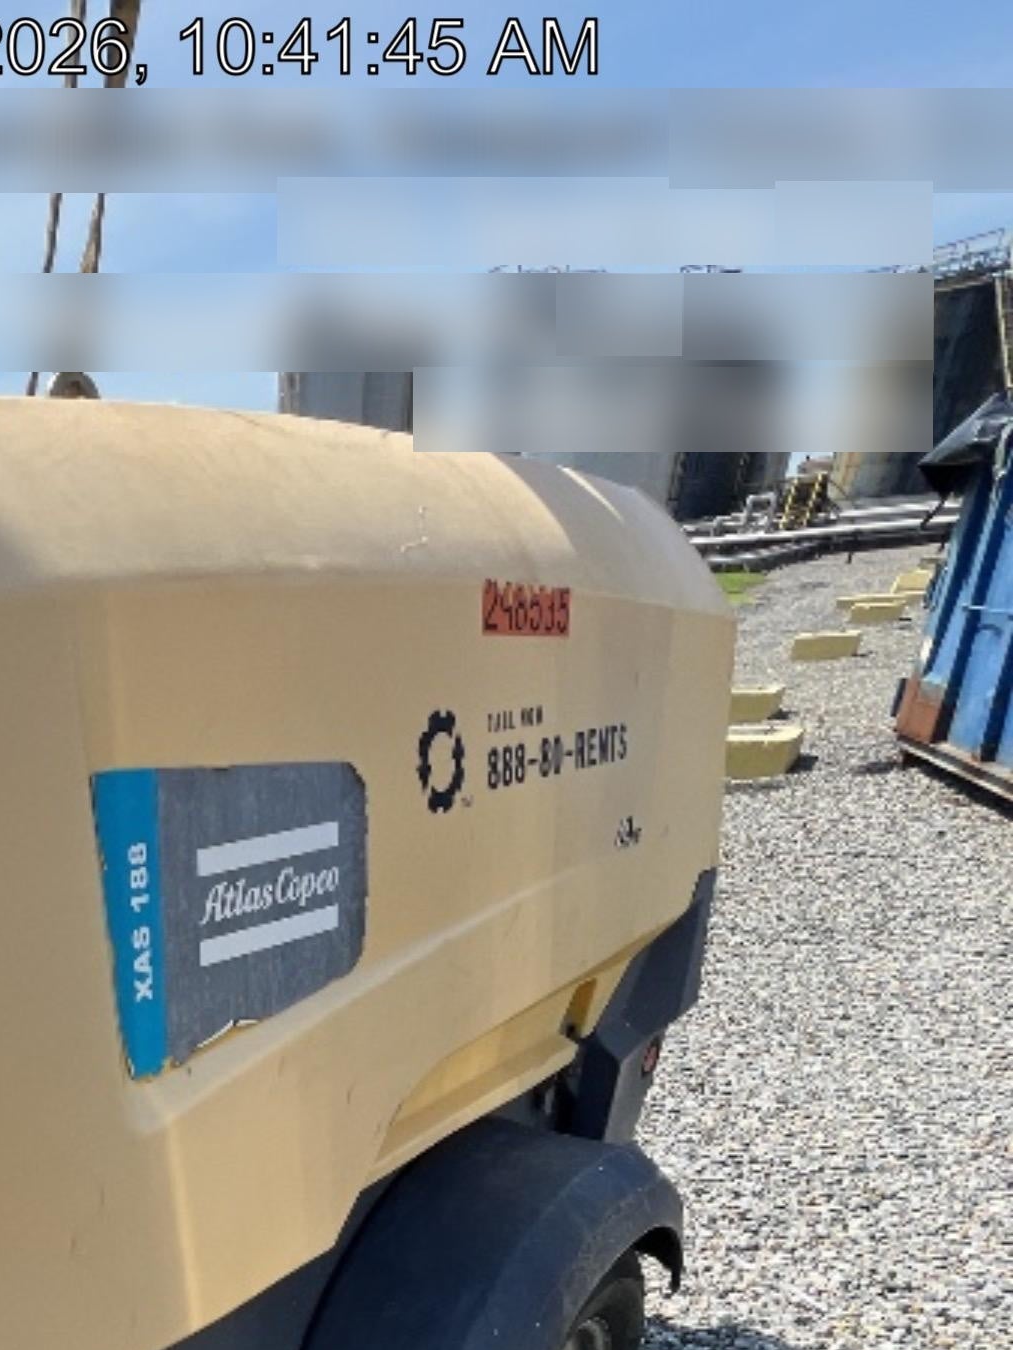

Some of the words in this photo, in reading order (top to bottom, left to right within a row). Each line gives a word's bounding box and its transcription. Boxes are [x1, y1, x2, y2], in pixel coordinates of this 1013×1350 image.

[487, 723, 627, 790] 888-80-RENTS
[127, 842, 150, 913] 188
[199, 878, 273, 925] Atlas
[275, 866, 339, 906] Copco
[133, 926, 154, 1002] XAS
